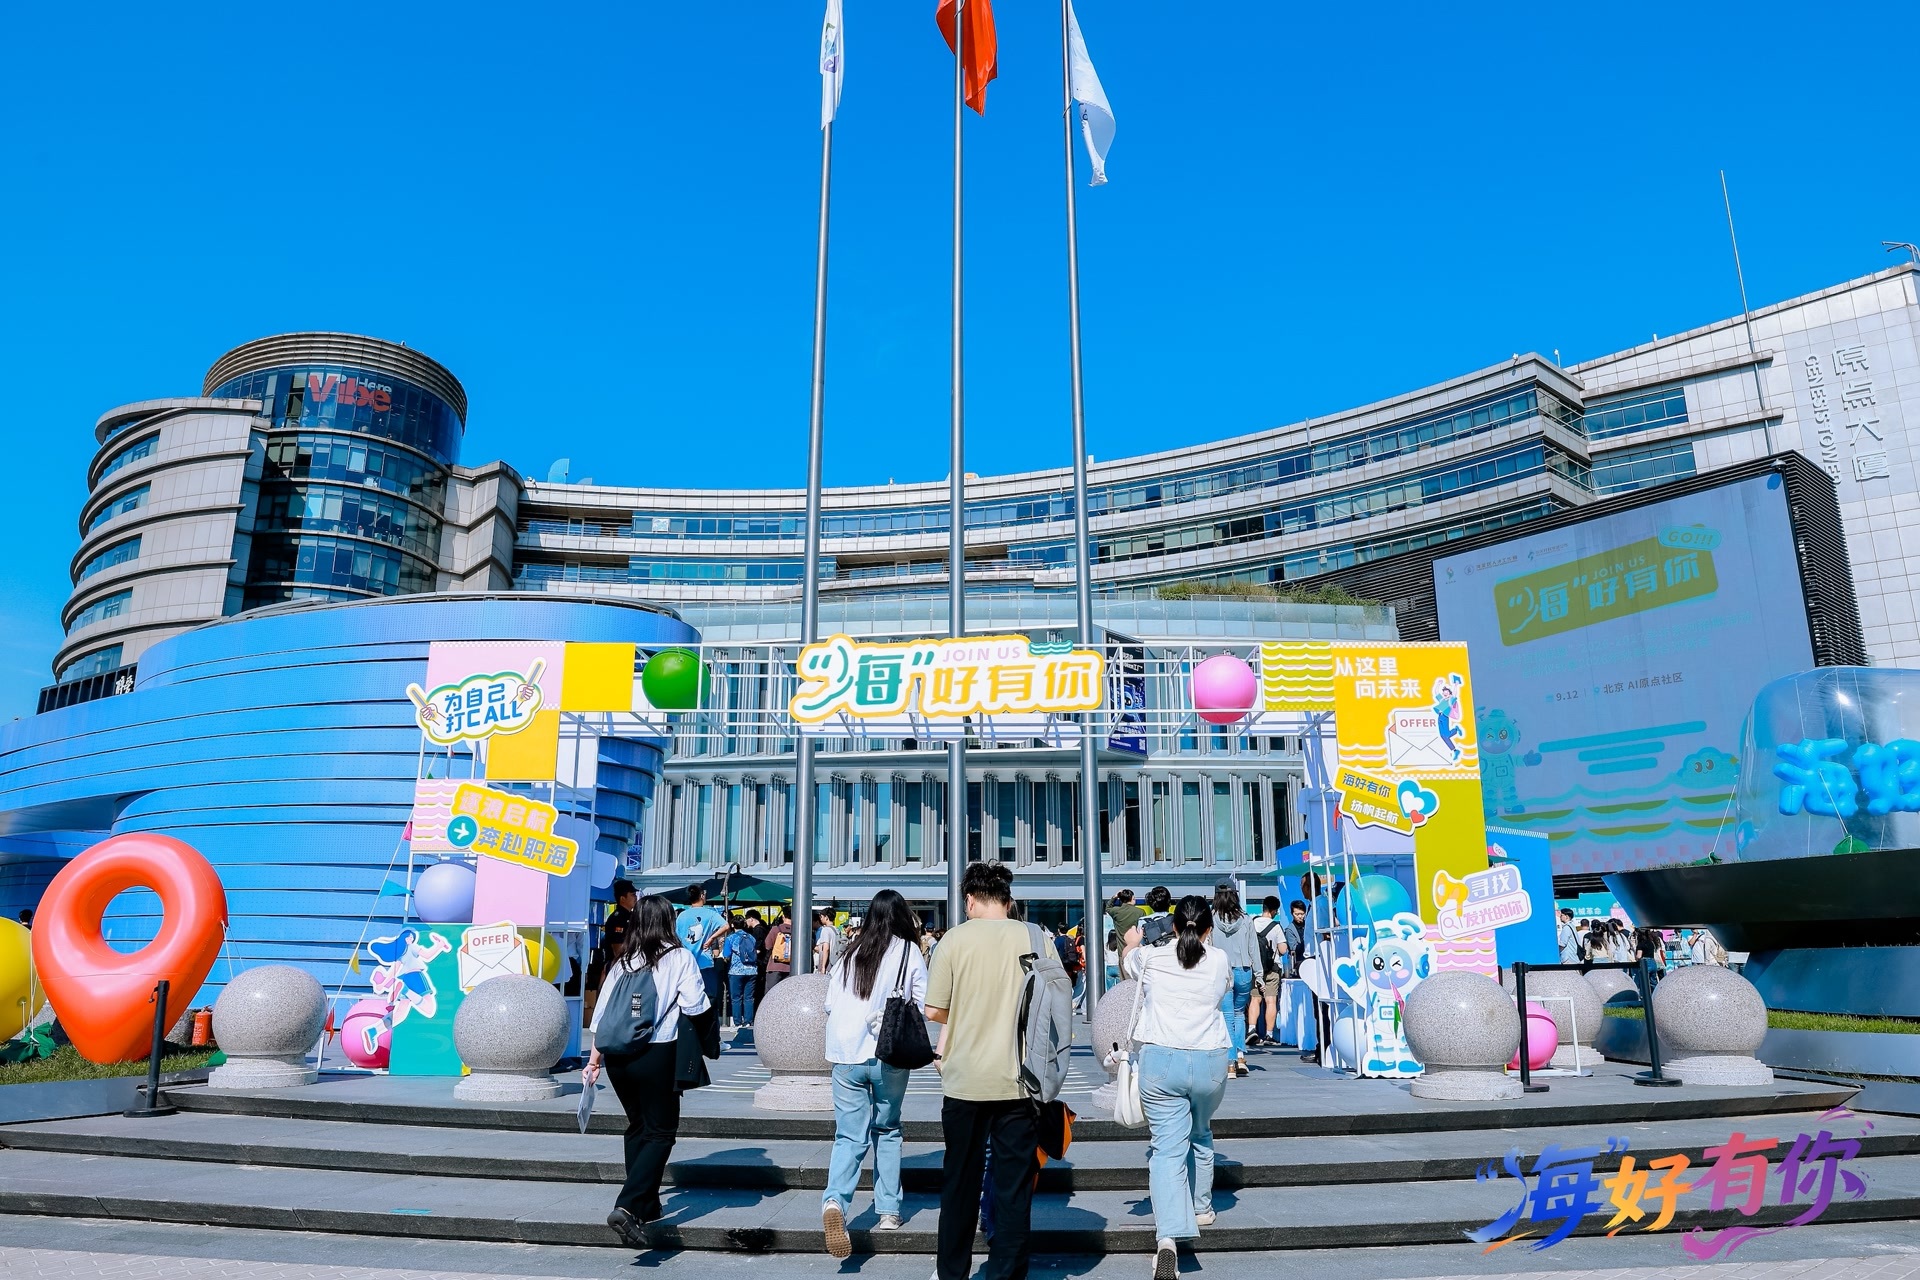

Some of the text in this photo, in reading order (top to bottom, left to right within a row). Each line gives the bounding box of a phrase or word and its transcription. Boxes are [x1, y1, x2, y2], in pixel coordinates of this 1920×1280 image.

[308, 374, 392, 413] Vibe
[1804, 354, 1831, 425] GENESIS
[1832, 344, 1891, 483] 原点大厦
[1667, 530, 1714, 546] GO!!!
[1592, 555, 1646, 581] JOIN US
[942, 645, 1021, 663] JOIN US
[1333, 655, 1399, 677] 从这里
[1355, 678, 1422, 699] 向未来
[1555, 690, 1579, 702] 9.12
[1603, 671, 1684, 695] 北京 AI原点社区
[444, 682, 506, 714] 为自己
[445, 700, 523, 734] 打CALL
[1399, 718, 1437, 728] OFFER
[1342, 772, 1392, 799] 海好有你
[1350, 799, 1400, 826] 扬帆起航
[478, 826, 570, 868] 奔赴职海
[1471, 872, 1512, 899] 寻找
[1463, 900, 1524, 928] 发光的你
[472, 933, 510, 947] OFFER
